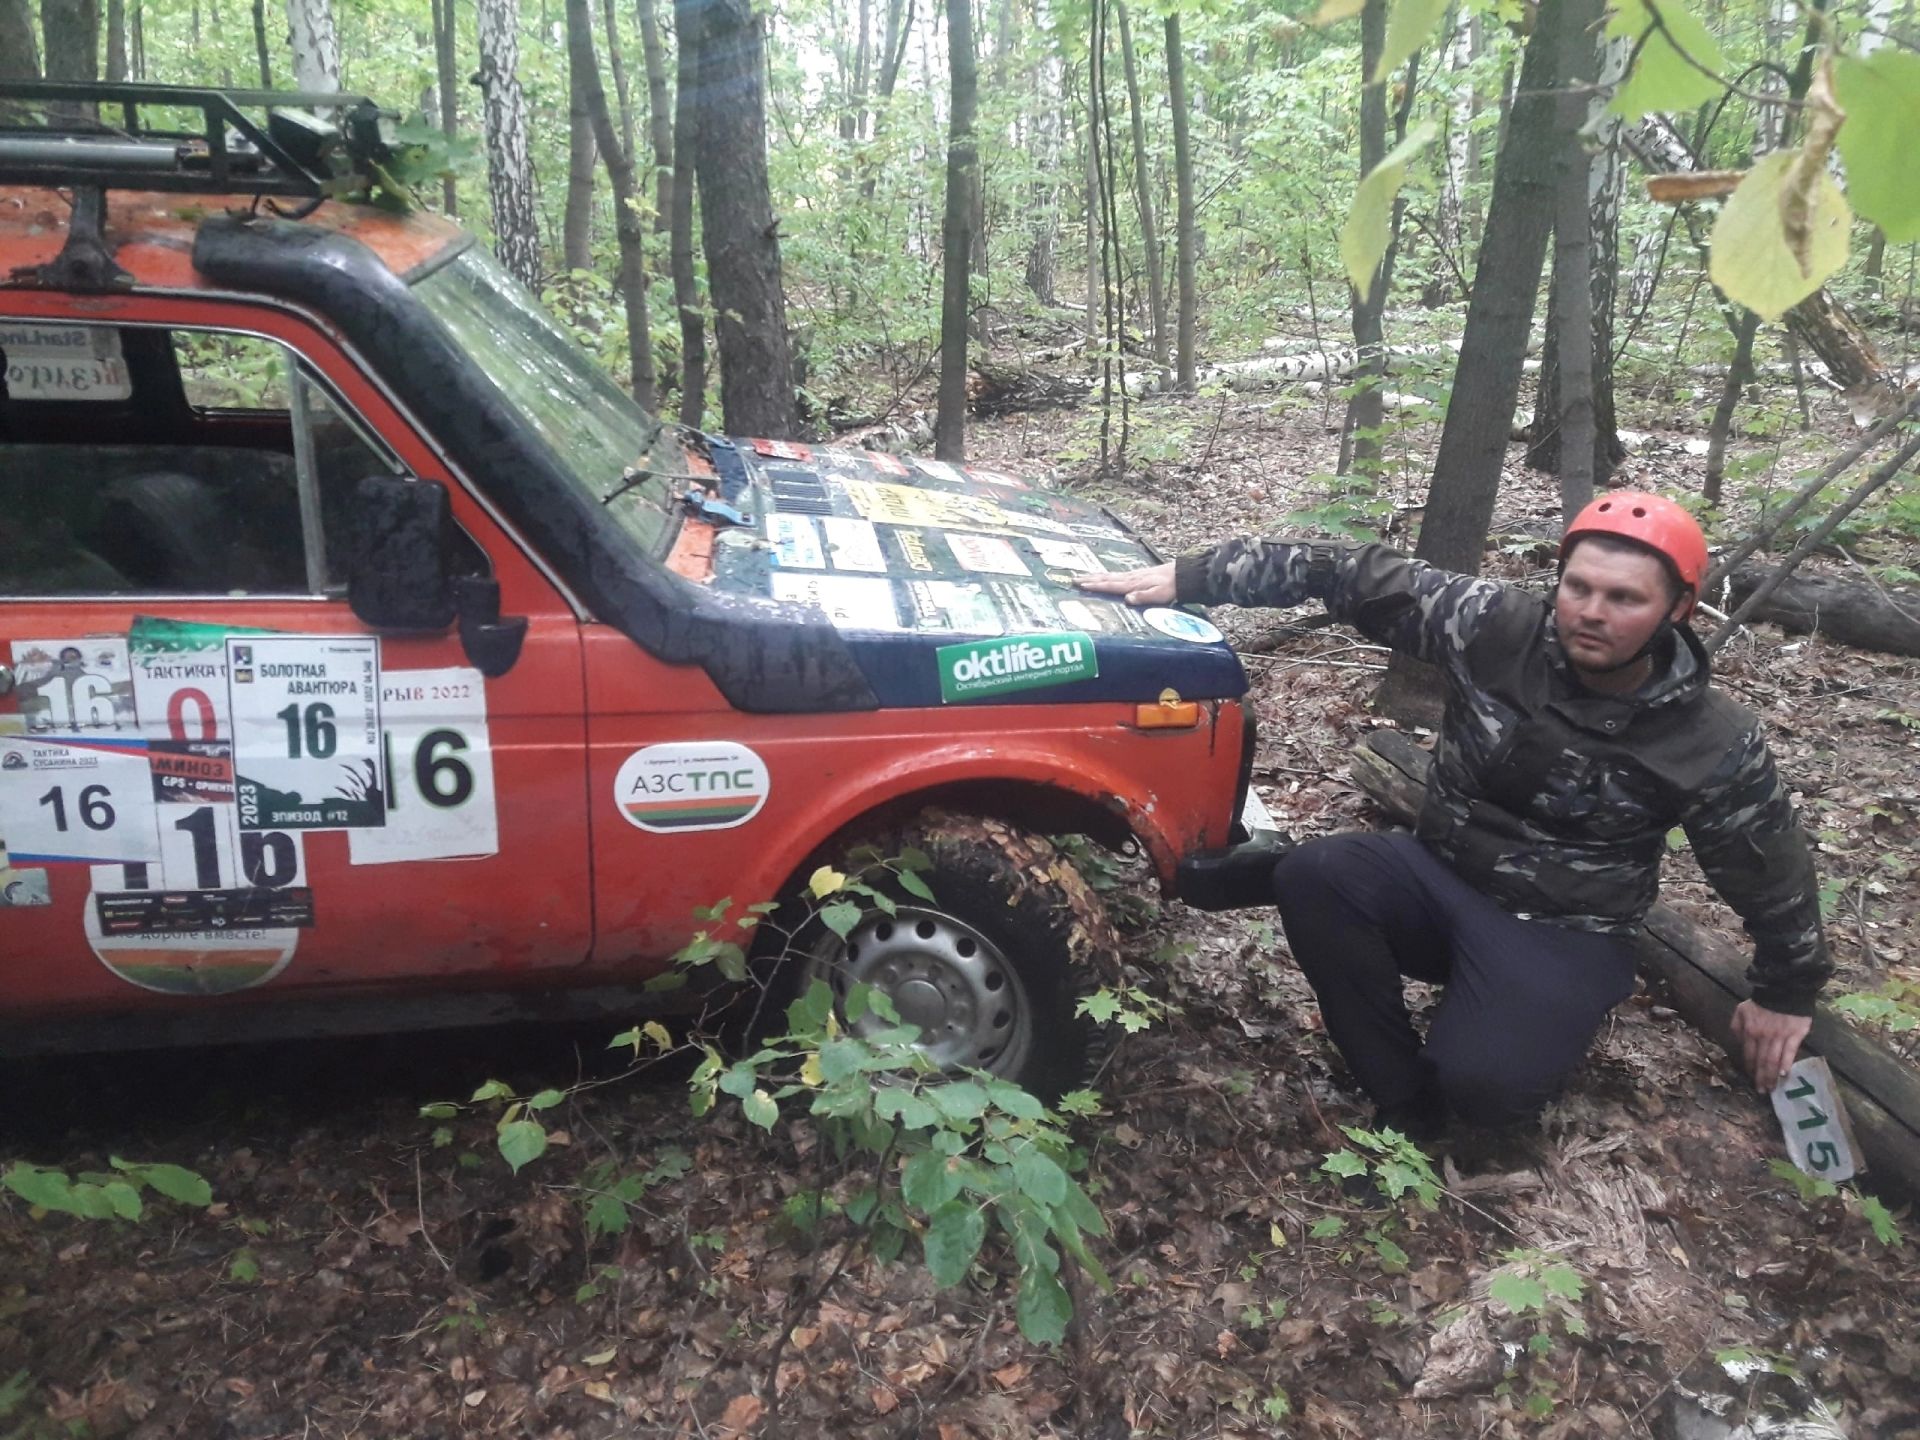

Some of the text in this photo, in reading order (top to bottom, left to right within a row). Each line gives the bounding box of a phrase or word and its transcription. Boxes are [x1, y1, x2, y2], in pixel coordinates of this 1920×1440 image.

[146, 665, 216, 679] ТАКТИКА
[260, 664, 326, 678] БОЛОТНАЯ
[953, 641, 1083, 682] oktlife.ru
[37, 674, 115, 728] 16
[287, 681, 357, 694] АВАНТЮРА
[431, 685, 472, 699] 2022
[276, 702, 337, 759] 16
[162, 776, 186, 789] GPS
[39, 784, 116, 832] 16
[239, 784, 259, 825] 2023
[271, 811, 323, 823] ЭПИЗОД
[1785, 1075, 1841, 1172] 115
